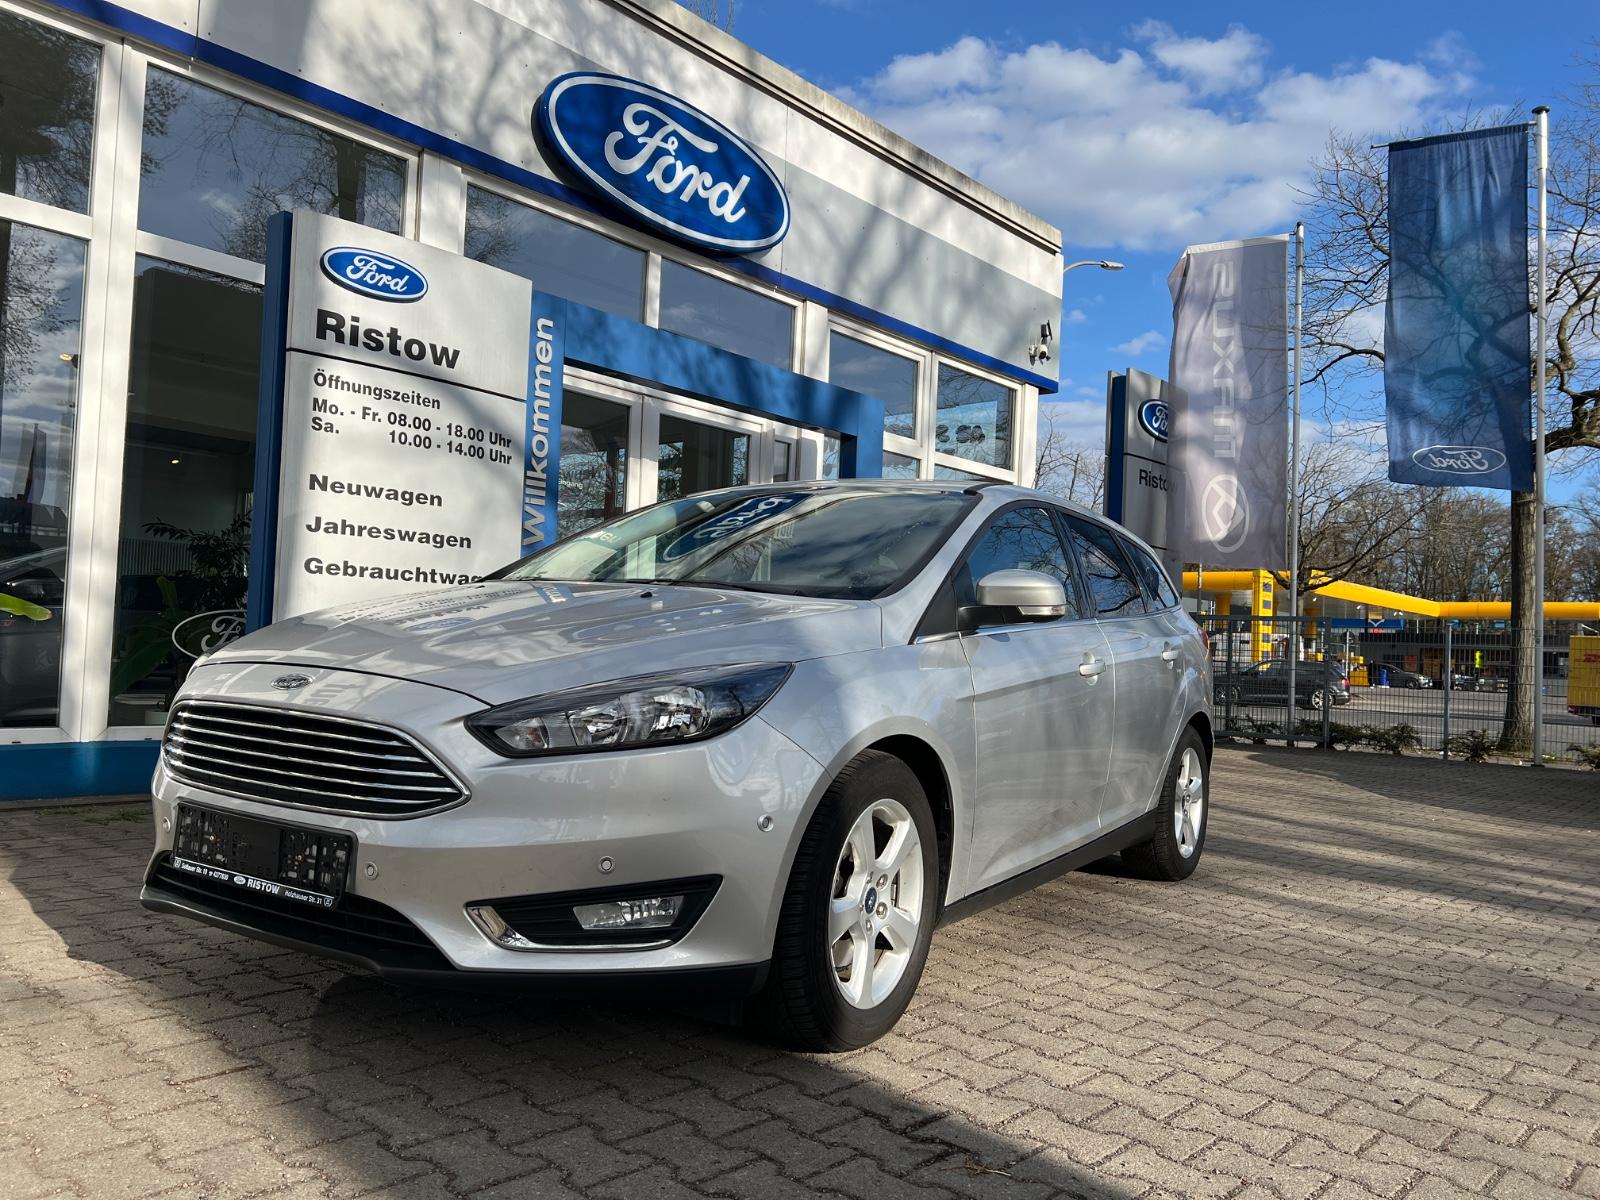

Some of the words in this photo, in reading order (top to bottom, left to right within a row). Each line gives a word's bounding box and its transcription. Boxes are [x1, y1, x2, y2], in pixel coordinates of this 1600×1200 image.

[604, 103, 750, 223] Ford
[346, 255, 407, 292] Ford
[316, 308, 461, 369] Ristow
[313, 368, 441, 409] Öffnungszeiten
[311, 416, 340, 434] Sa.
[389, 430, 432, 449] 10.00
[446, 441, 485, 459] 14.00
[489, 449, 512, 465] Uhr
[312, 397, 344, 416] Mo.
[361, 406, 382, 423] Fr.
[387, 411, 432, 432] 08.00
[446, 423, 485, 442] 18.00
[489, 432, 512, 448] Uhr
[522, 317, 554, 545] Willkommen
[308, 473, 443, 507] Neuwagen
[1138, 468, 1171, 492] Risto
[305, 516, 472, 549] Jahreswagen
[247, 878, 280, 894] RISTOW
